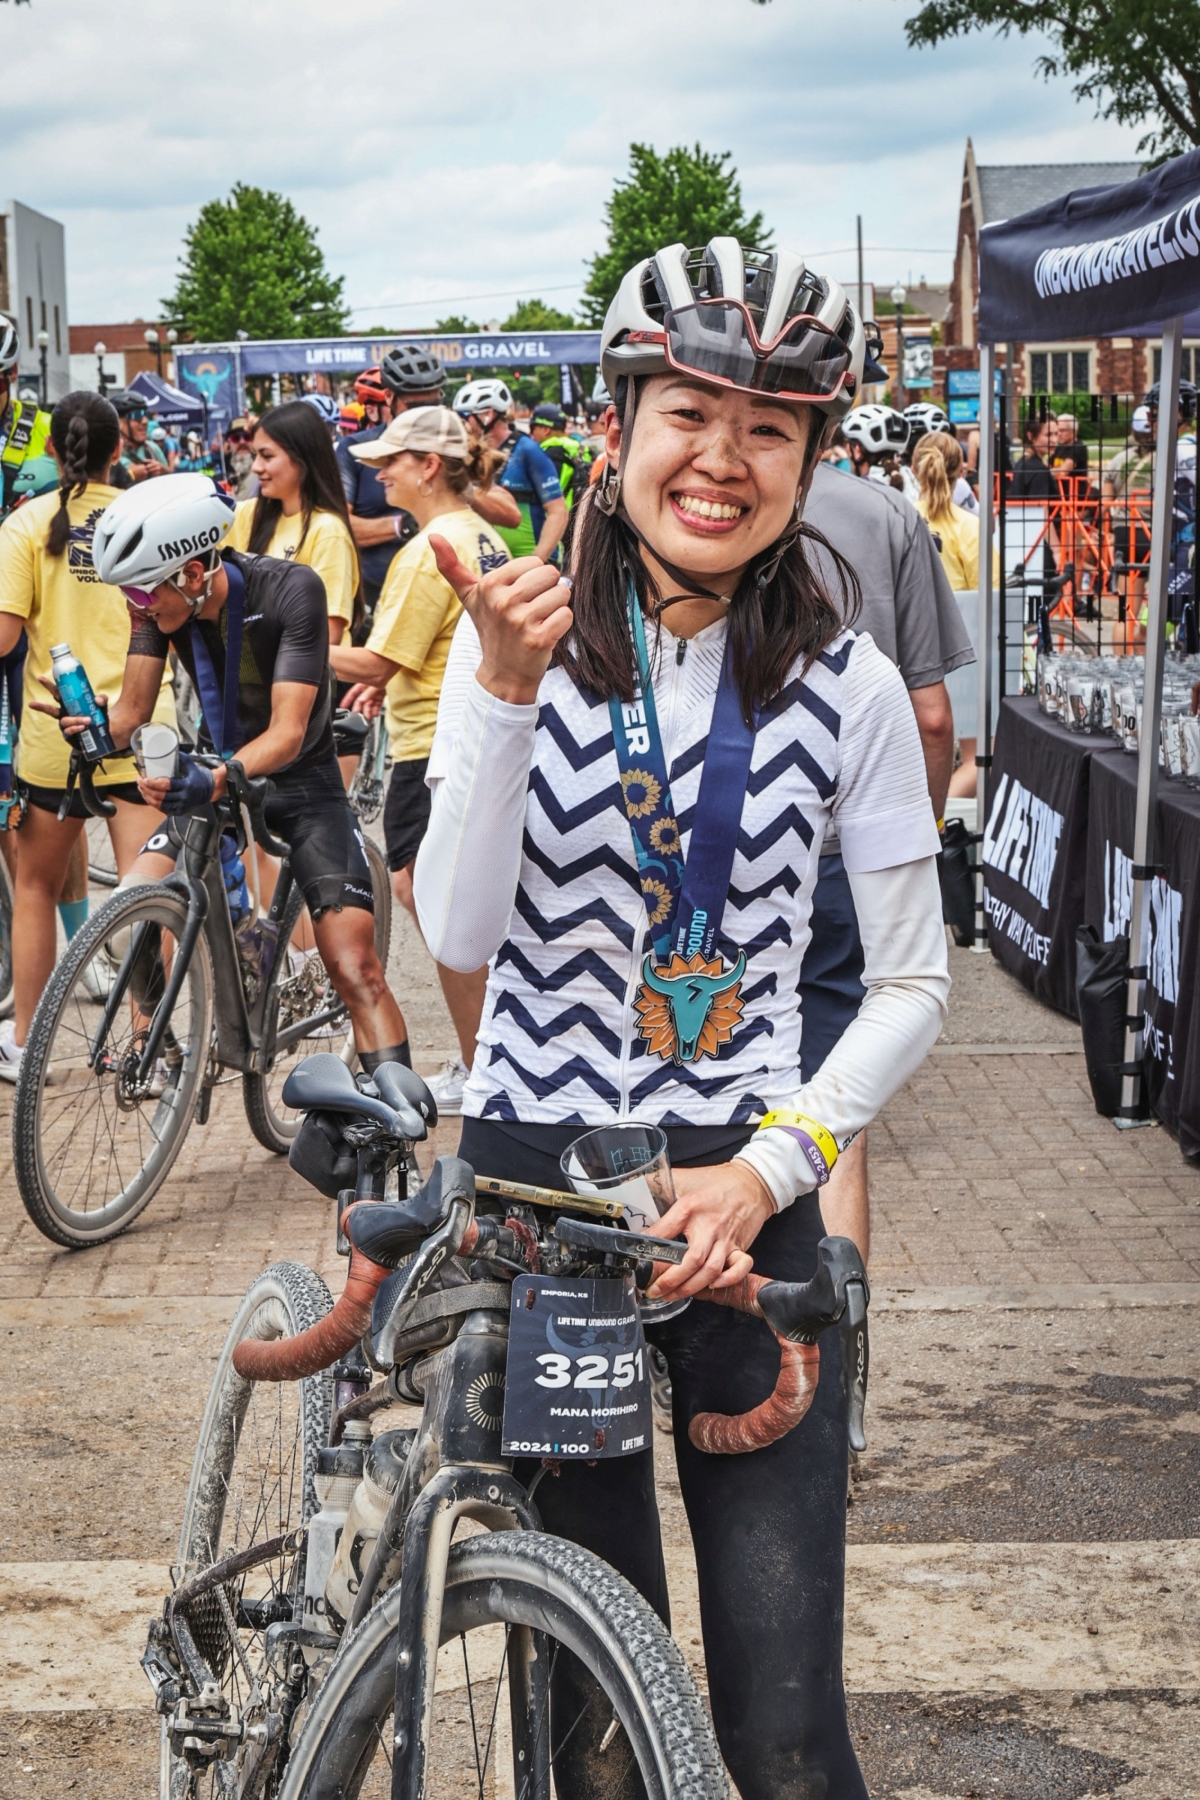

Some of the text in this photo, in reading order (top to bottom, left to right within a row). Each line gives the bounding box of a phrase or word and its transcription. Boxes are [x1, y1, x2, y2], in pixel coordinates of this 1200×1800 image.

[464, 341, 551, 359] GRAVEL
[157, 525, 220, 561] INDIGO
[69, 568, 98, 576] UNBO
[1028, 932, 1052, 966] LIFE
[636, 1243, 679, 1260] GARMIN
[410, 1246, 448, 1302] GRX
[541, 1289, 577, 1299] EMPORIA,
[617, 1314, 636, 1327] GRAVEL
[856, 1330, 865, 1385] GRX
[533, 1347, 644, 1389] 3251
[550, 1402, 639, 1418] MANA MORIHIRO
[509, 1440, 590, 1455] 2024 100
